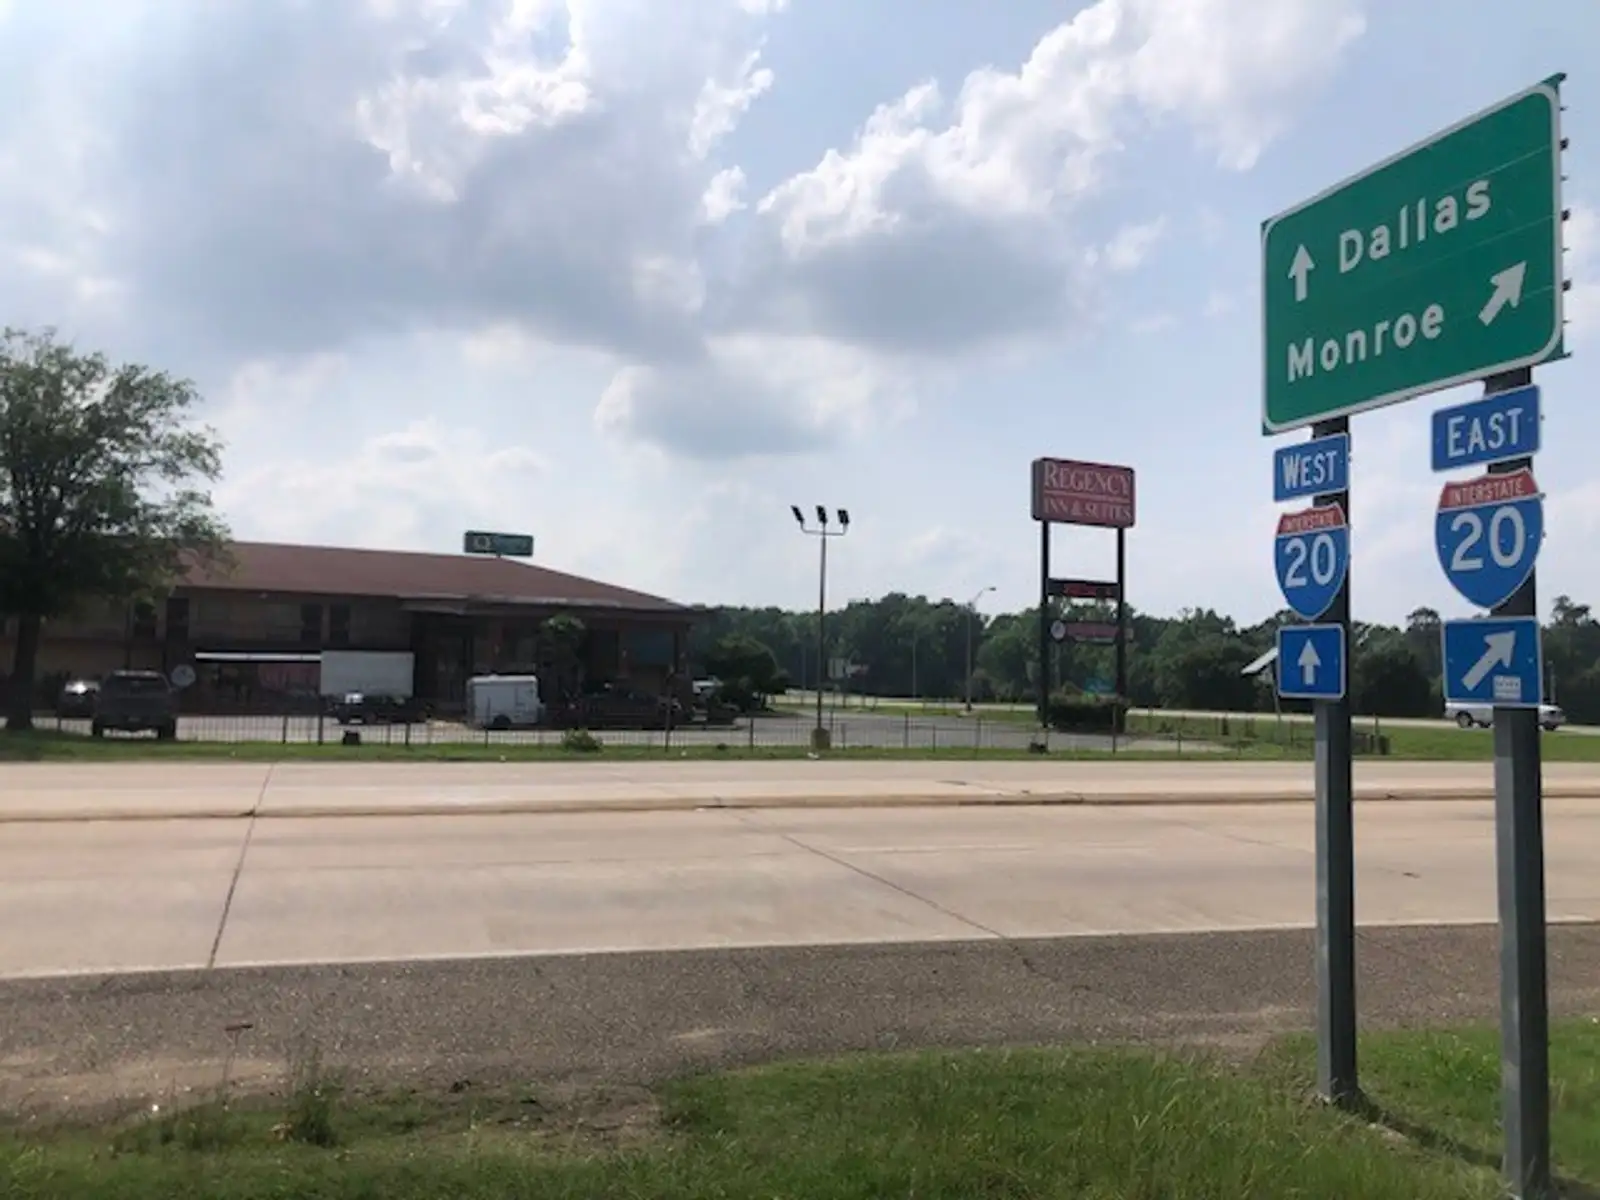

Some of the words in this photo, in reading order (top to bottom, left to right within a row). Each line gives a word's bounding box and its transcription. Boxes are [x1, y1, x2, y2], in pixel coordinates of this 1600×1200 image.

[1339, 179, 1492, 274] Dallas
[1287, 303, 1444, 383] Monroe
[1447, 407, 1525, 459] EAST
[1044, 462, 1131, 496] REGENCY
[1283, 449, 1338, 489] WEST
[1450, 477, 1526, 505] INTERSTATE
[1044, 498, 1068, 515] INN
[1285, 511, 1337, 532] INTERSTATE
[1284, 534, 1336, 588] 20
[1450, 505, 1527, 572] 20
